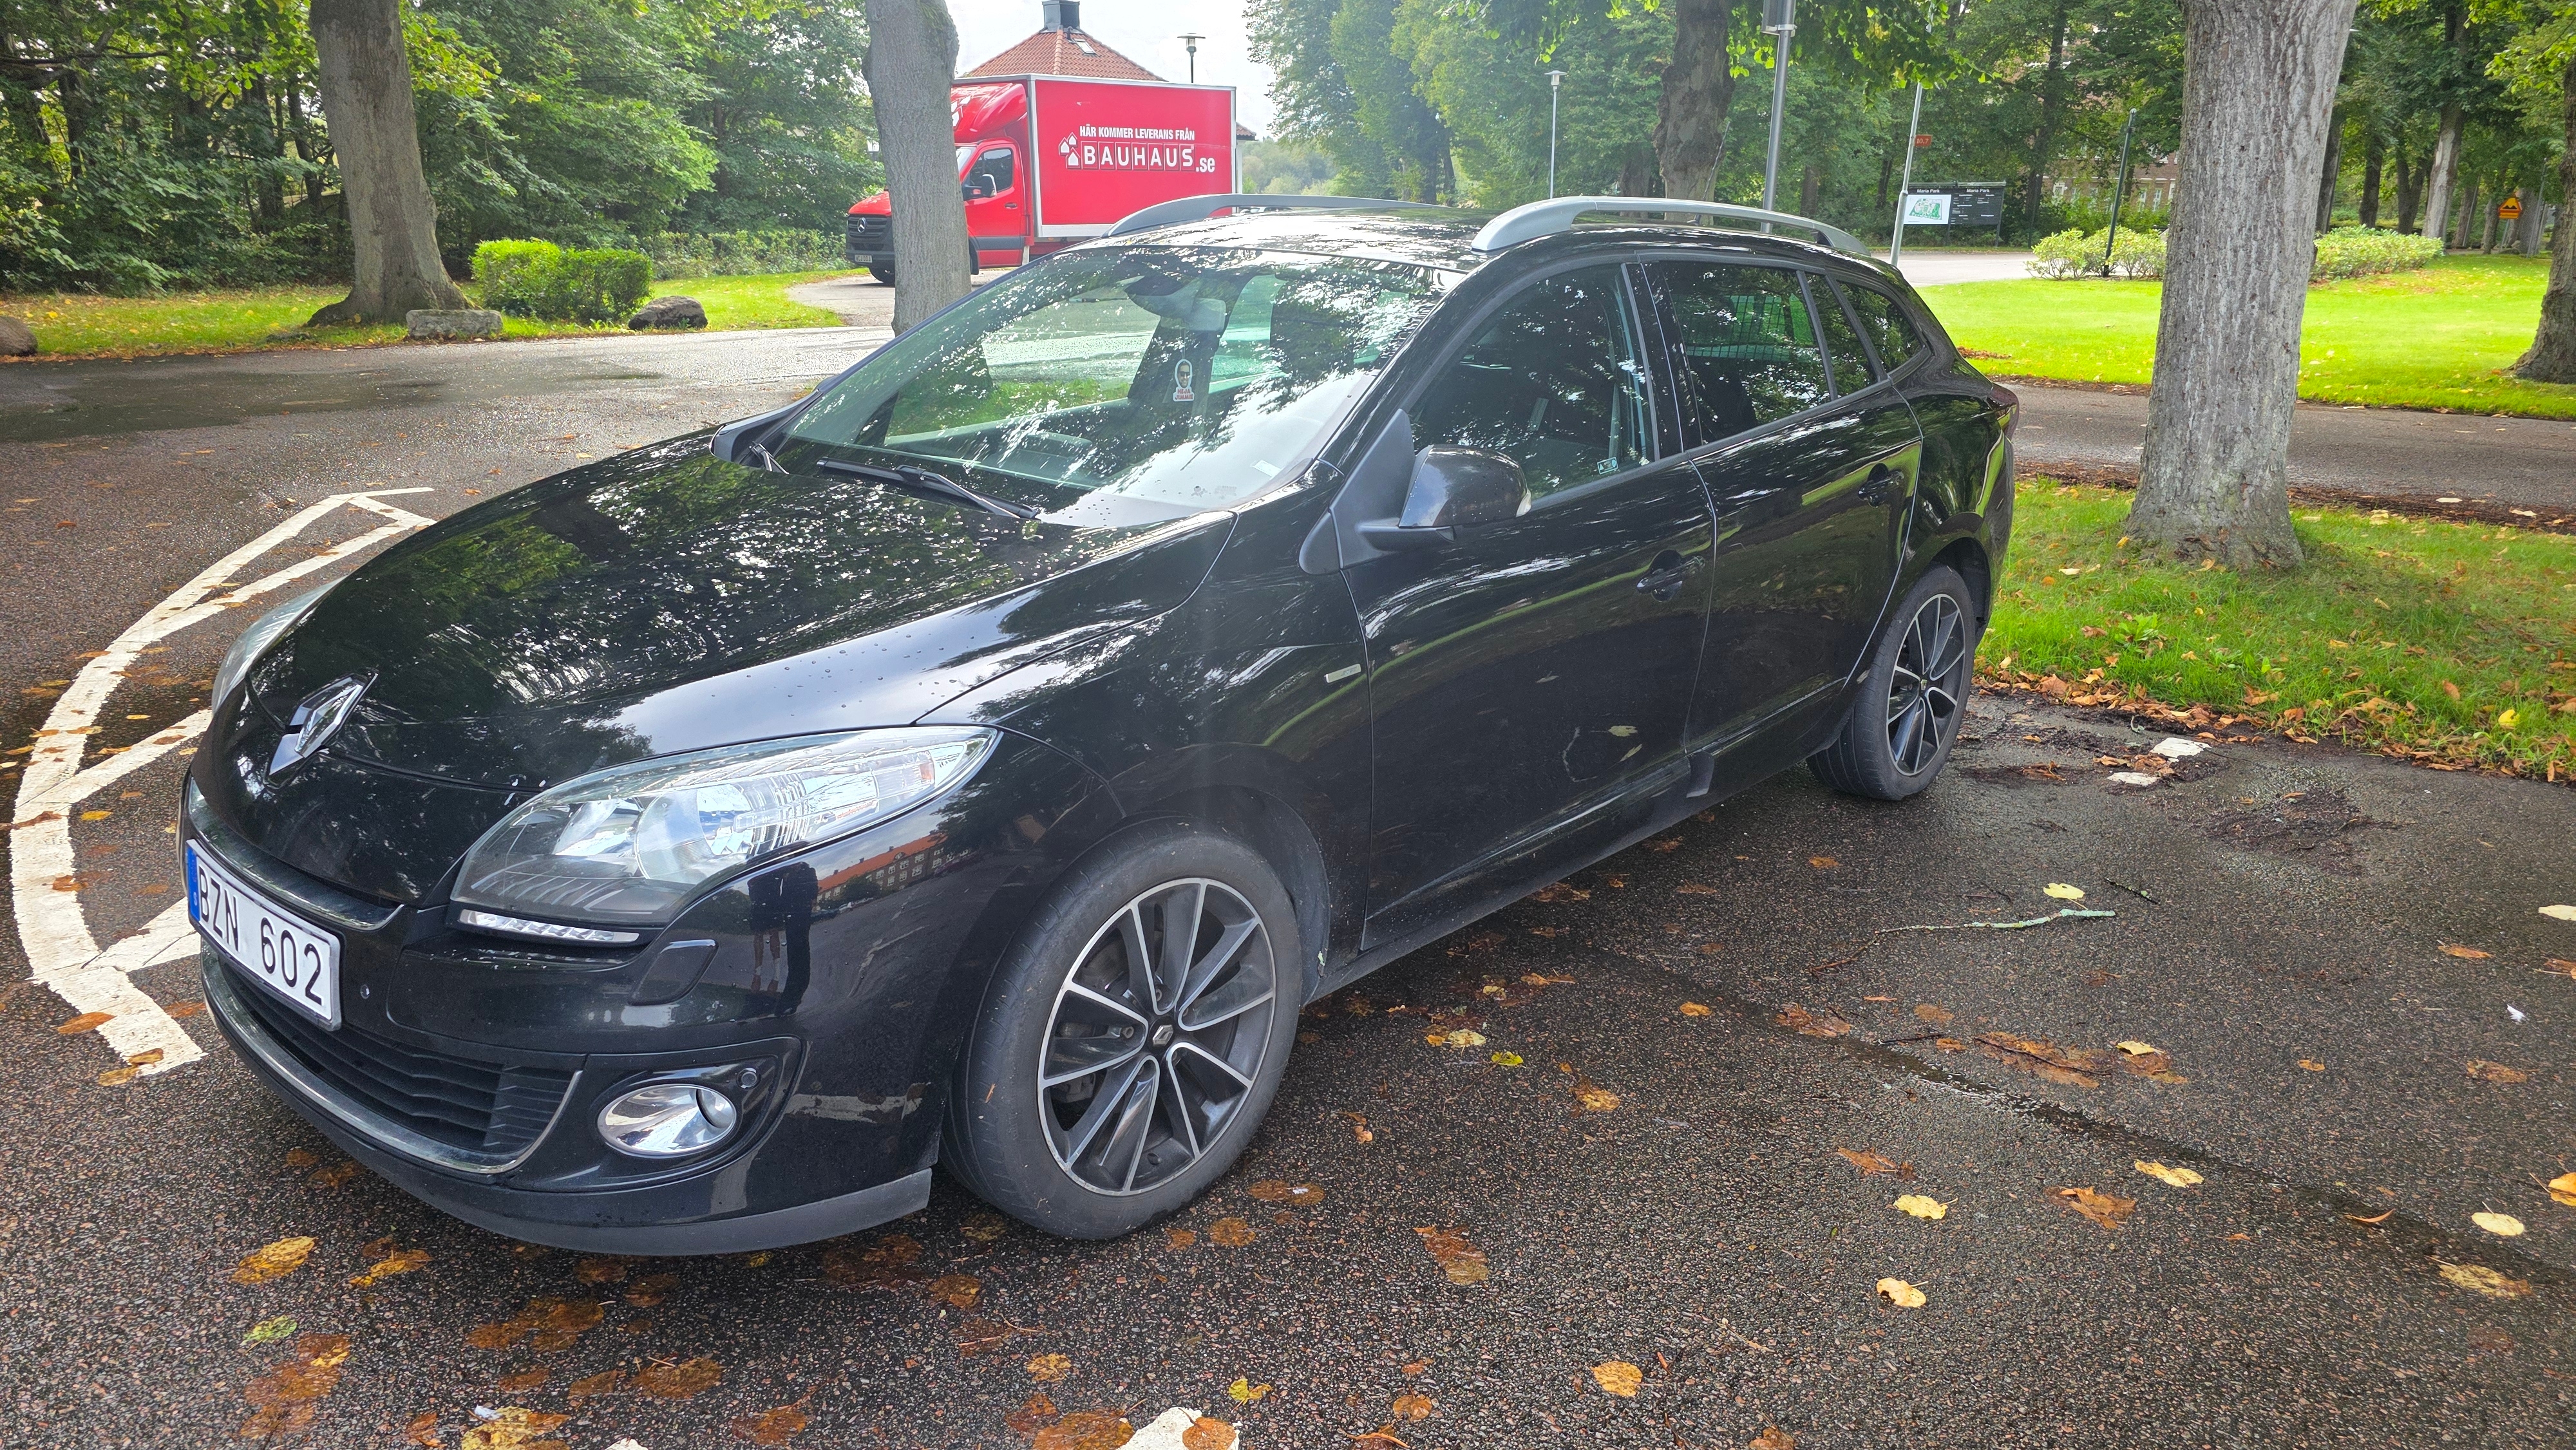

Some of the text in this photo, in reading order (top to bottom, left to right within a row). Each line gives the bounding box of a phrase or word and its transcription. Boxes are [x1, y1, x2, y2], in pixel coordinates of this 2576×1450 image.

[1079, 124, 1195, 140] HÄR KOMMER LEVERANS FRÅN
[198, 865, 323, 1006] BZN 602
